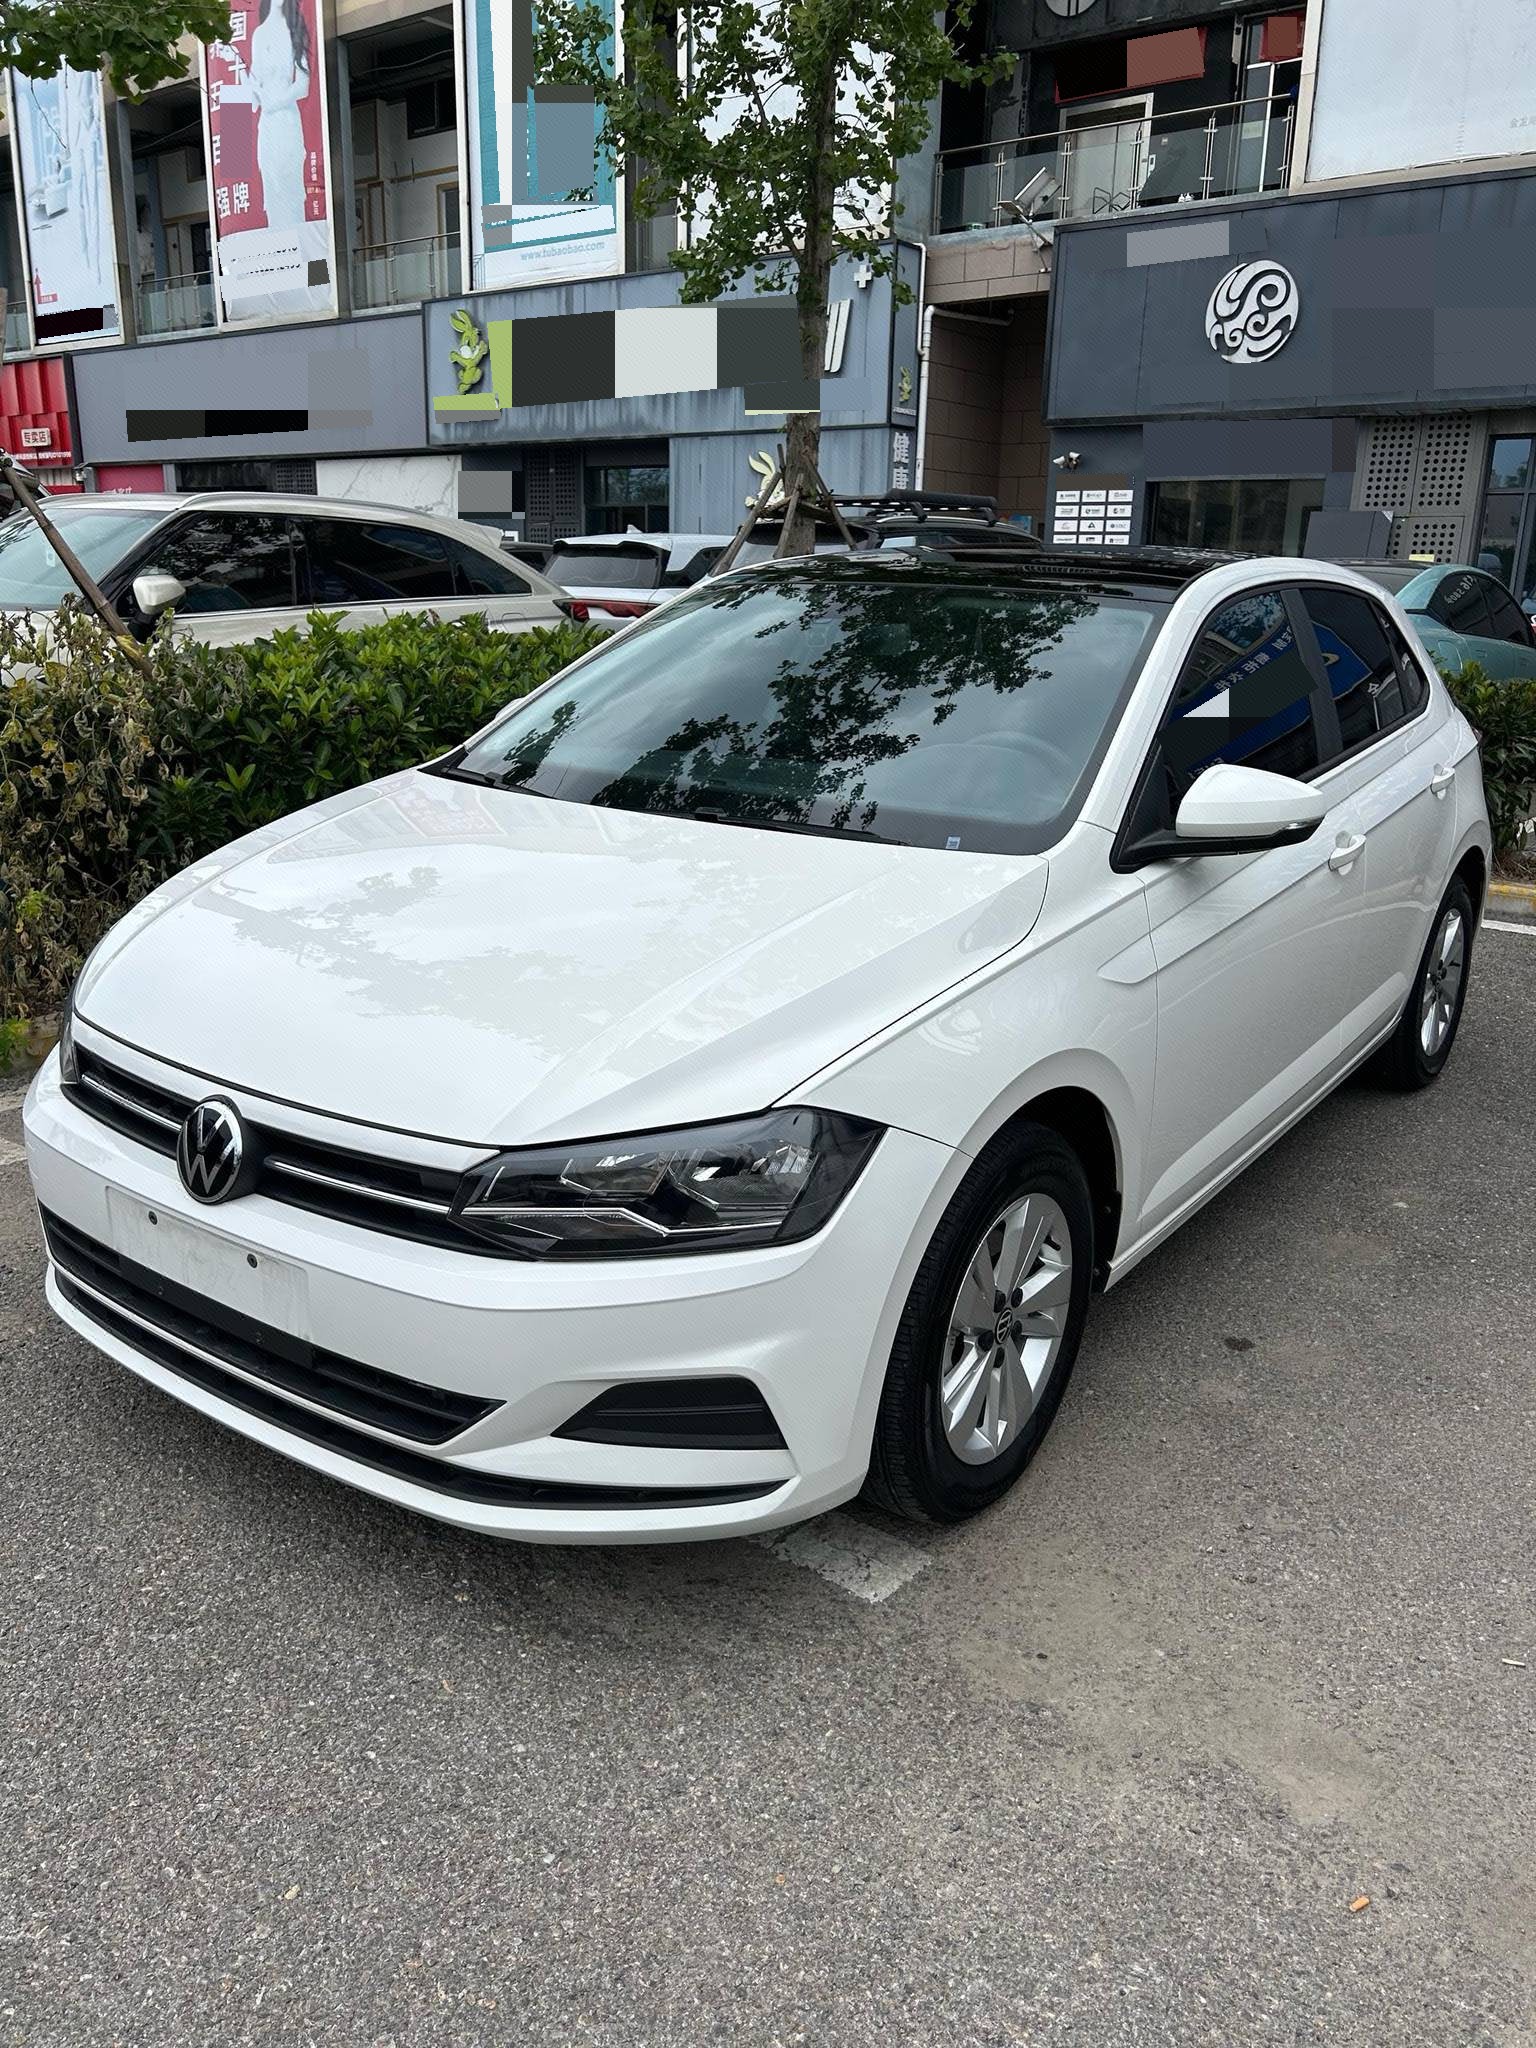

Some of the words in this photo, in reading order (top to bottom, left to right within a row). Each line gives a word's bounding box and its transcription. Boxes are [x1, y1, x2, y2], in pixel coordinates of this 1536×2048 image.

[521, 241, 605, 261] www.tubaobao.com
[23, 431, 47, 444] 专卖店
[181, 1102, 241, 1198] VW
